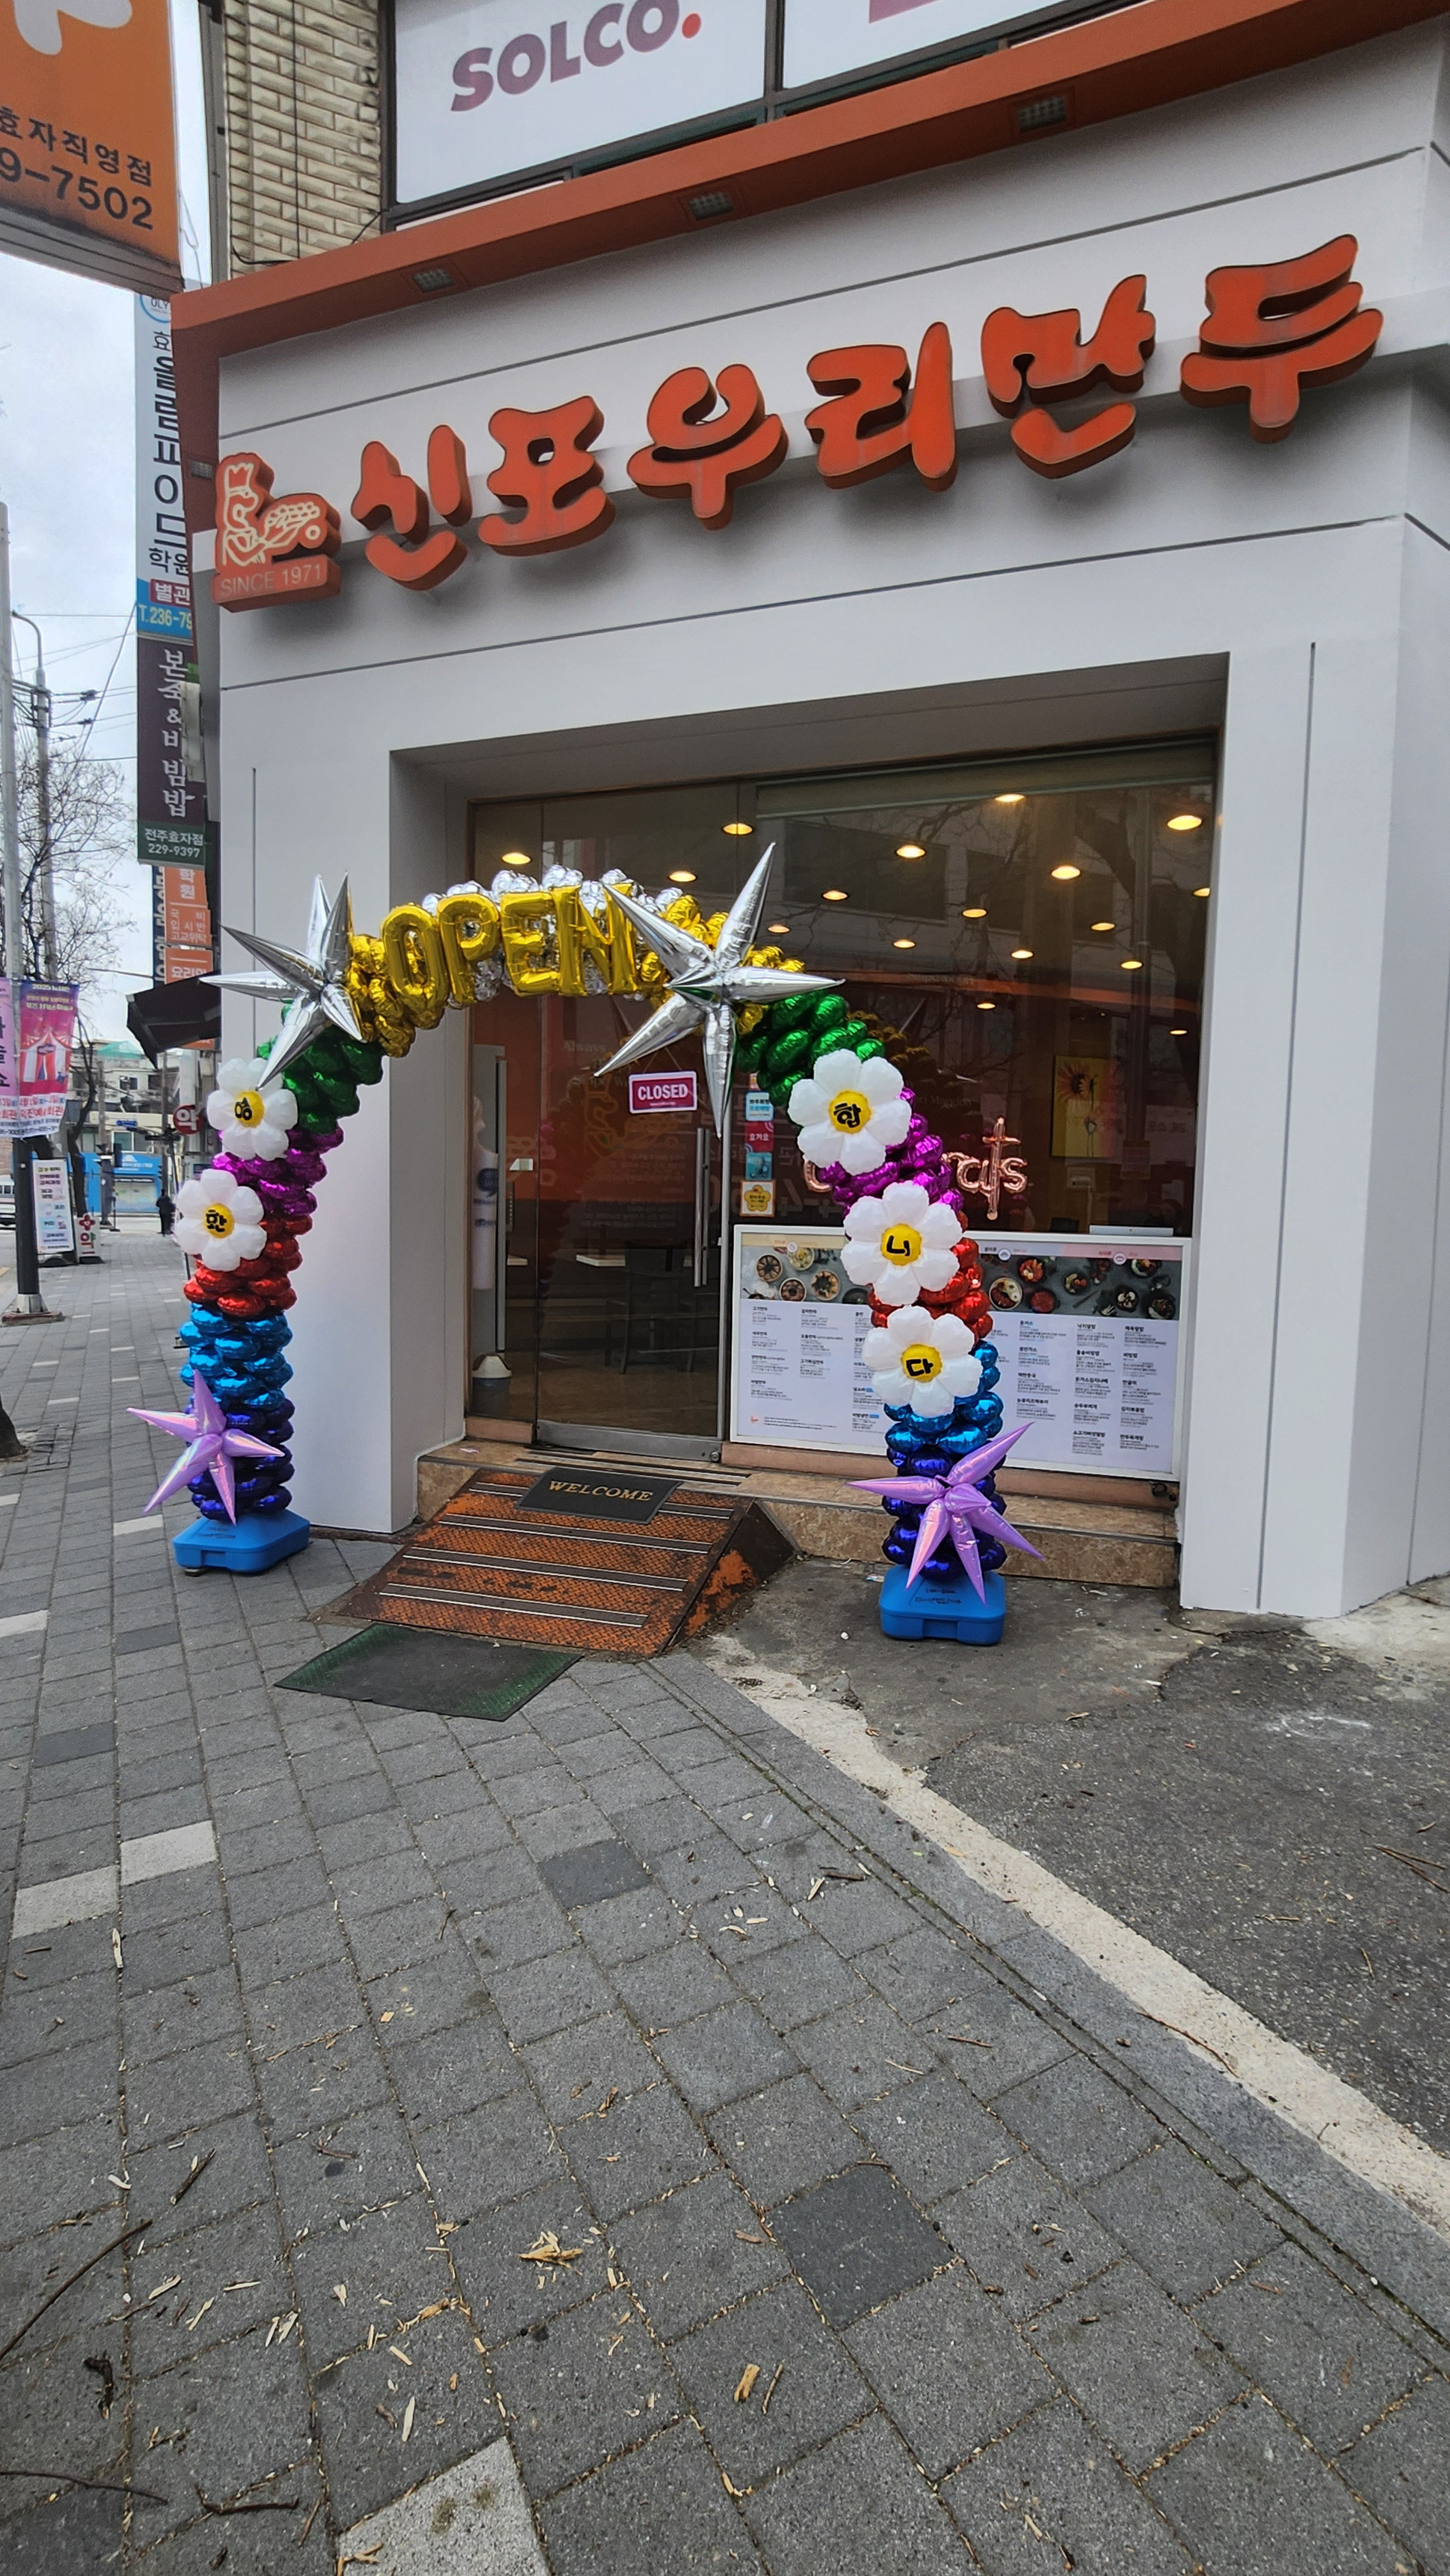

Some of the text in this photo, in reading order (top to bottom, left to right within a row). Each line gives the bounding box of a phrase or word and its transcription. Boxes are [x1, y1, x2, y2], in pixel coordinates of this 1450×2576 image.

[0, 106, 152, 187] 효자직영점
[0, 147, 153, 230] 9-7502
[351, 234, 1384, 591] 신포우리만두
[220, 563, 321, 597] SINCE 1971
[144, 828, 203, 846] 전주효자점
[147, 843, 201, 858] 229-9397
[381, 882, 639, 1029] OPEN
[637, 1083, 688, 1101] CLOSED
[234, 1097, 253, 1121] 영
[833, 1103, 862, 1128] 합
[749, 1133, 769, 1142] 요기요
[205, 1209, 227, 1233] 환
[886, 1235, 910, 1256] 니
[906, 1357, 934, 1377] 다
[549, 1480, 654, 1501] WELCOME
